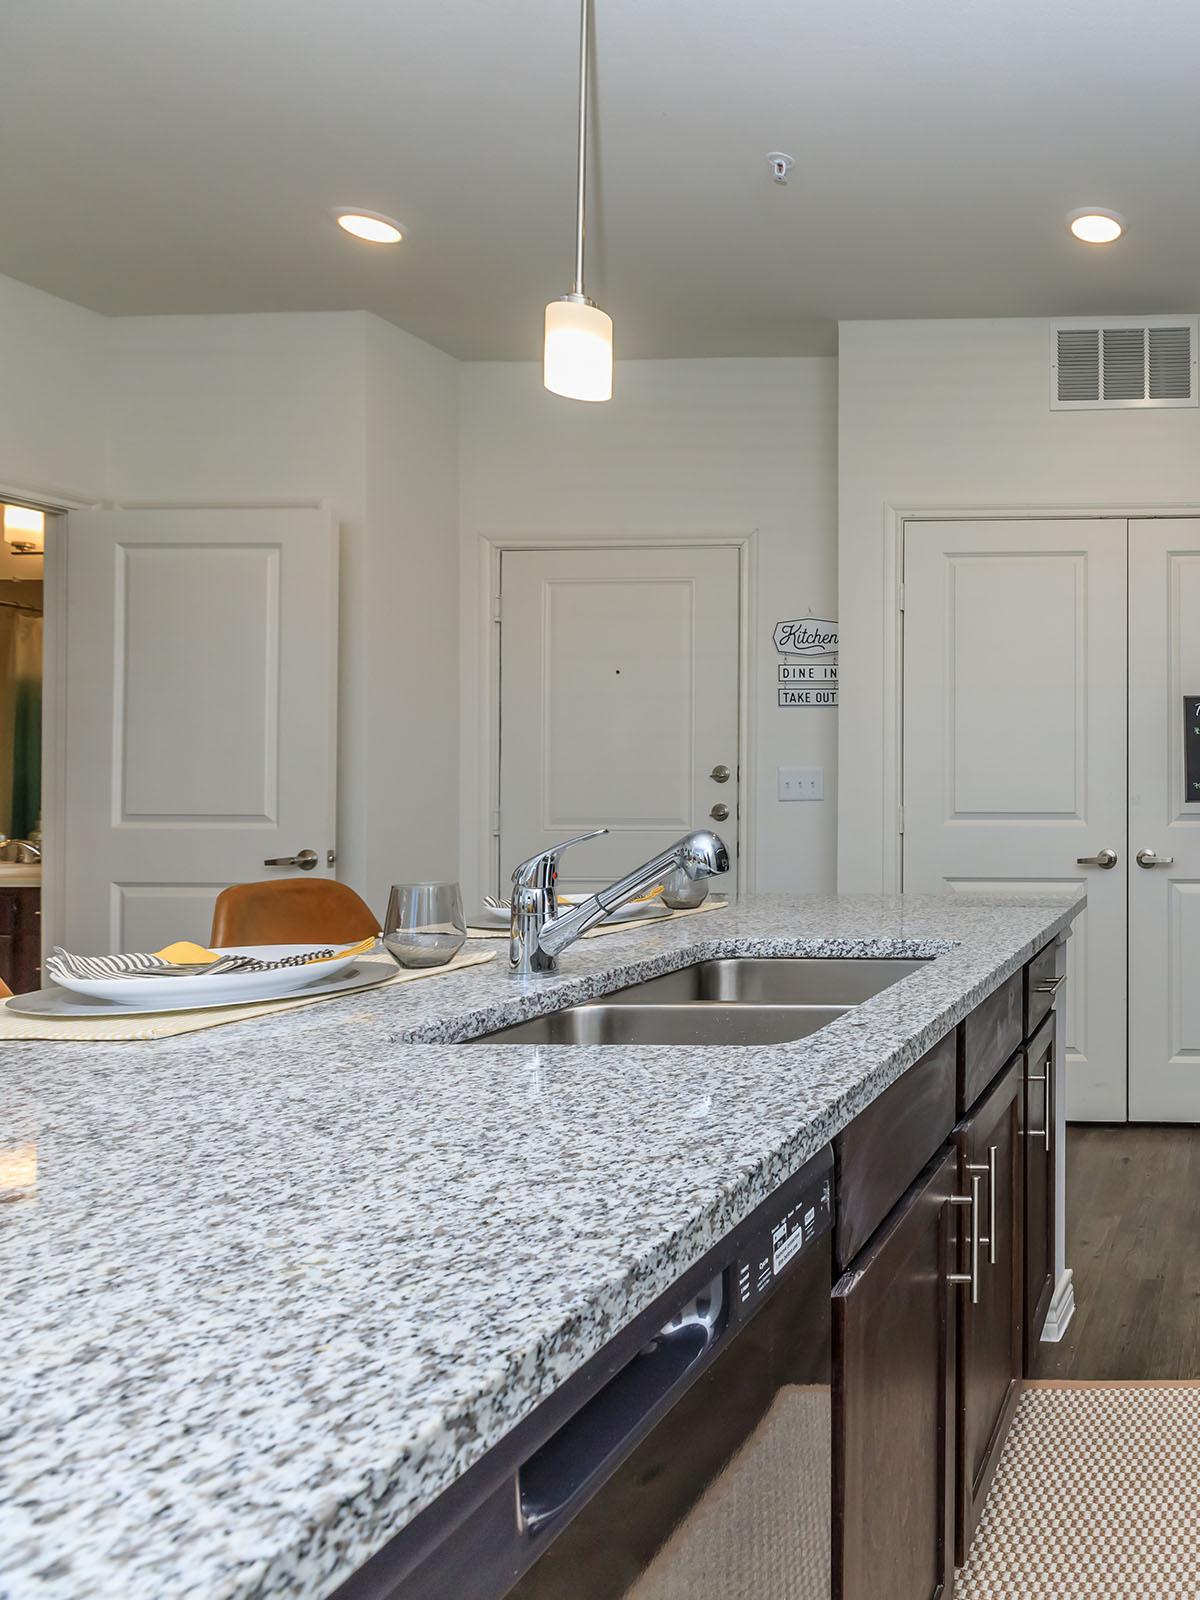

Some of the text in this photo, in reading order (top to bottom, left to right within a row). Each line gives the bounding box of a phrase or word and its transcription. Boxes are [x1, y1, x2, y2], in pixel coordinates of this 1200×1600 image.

[779, 624, 839, 650] Kitchen
[783, 668, 837, 679] DINE IN
[783, 692, 837, 703] TAKE OUT
